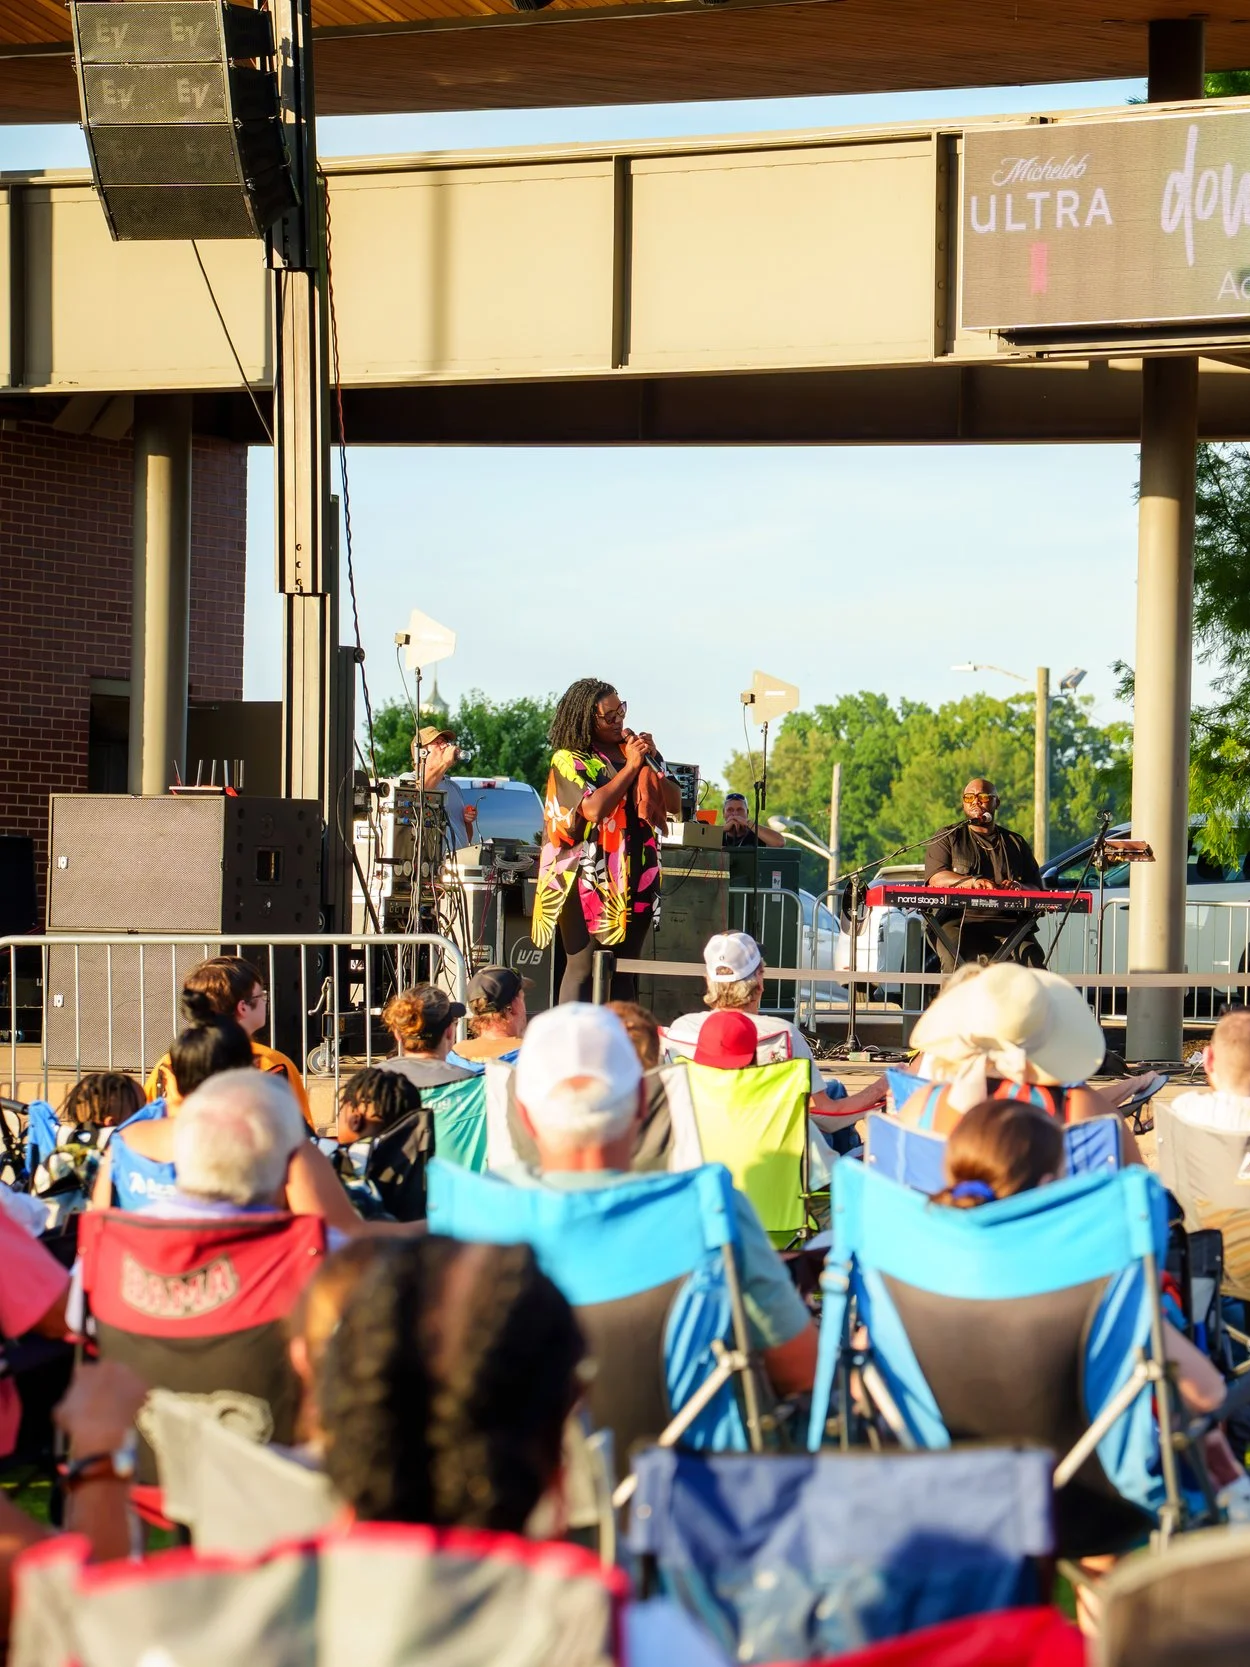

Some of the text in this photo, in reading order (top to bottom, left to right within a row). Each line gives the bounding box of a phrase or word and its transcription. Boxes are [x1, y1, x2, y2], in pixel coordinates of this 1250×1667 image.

[992, 153, 1092, 187] Michelob
[970, 188, 1114, 234] ULTRA
[897, 896, 945, 906] nord stage 3
